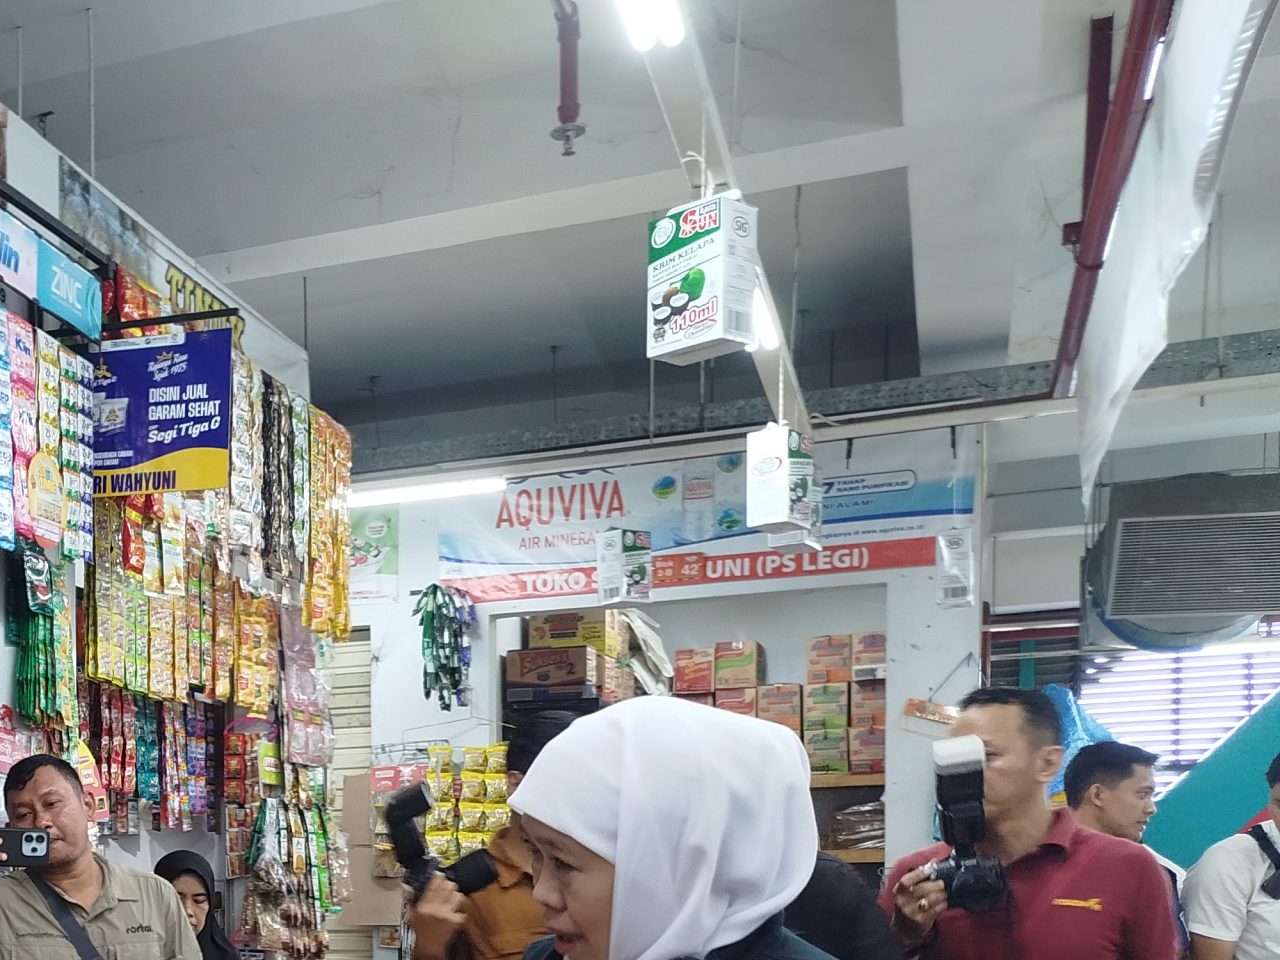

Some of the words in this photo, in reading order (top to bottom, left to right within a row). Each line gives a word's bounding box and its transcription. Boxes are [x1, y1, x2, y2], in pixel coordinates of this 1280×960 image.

[51, 265, 83, 311] ZINC
[671, 297, 718, 334] 110ml
[149, 385, 181, 403] DISINI
[182, 383, 209, 400] JUAL
[148, 403, 186, 421] GARAM
[188, 400, 222, 418] SEHAT
[180, 420, 210, 438] Tiga
[211, 416, 221, 430] G
[111, 469, 177, 494] WAHYUNI
[823, 481, 835, 495] 7
[495, 479, 626, 531] AQUVIVA
[519, 535, 541, 550] AIR
[544, 530, 600, 549] MINERA
[756, 553, 796, 578] (PS
[802, 547, 869, 572] LEGI)
[522, 571, 586, 594] TOKO
